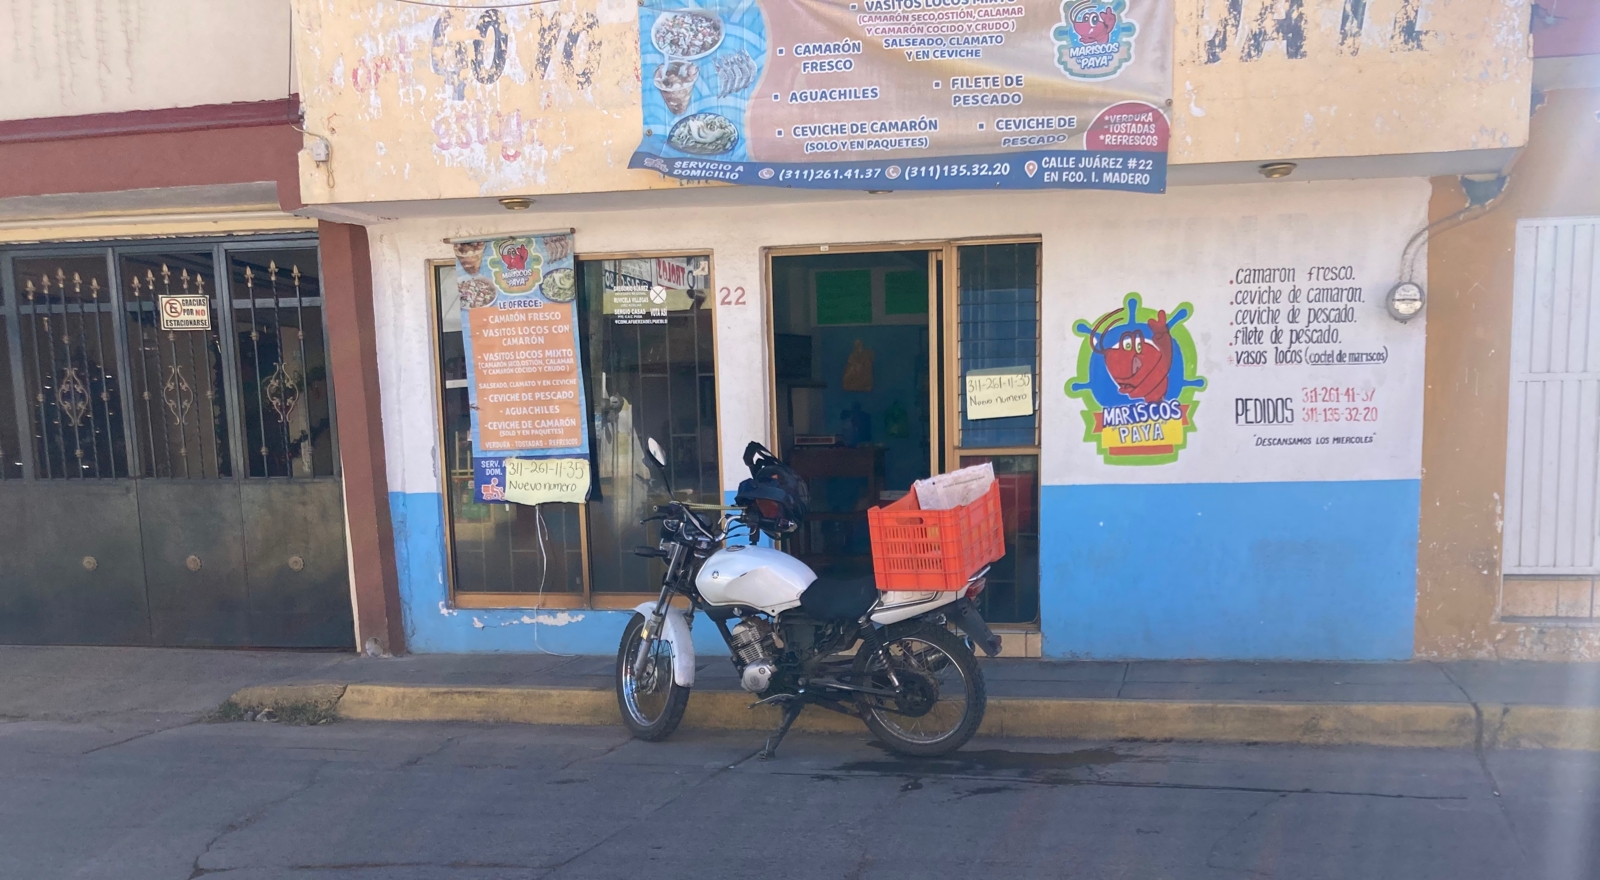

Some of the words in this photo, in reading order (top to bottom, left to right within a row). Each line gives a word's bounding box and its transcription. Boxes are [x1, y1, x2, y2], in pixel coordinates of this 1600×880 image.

[866, 0, 921, 11] VASITOS
[858, 14, 909, 24] (CAMARÓN
[977, 7, 1024, 18] CALAMAR
[874, 24, 924, 34] CAMARÓN
[926, 24, 964, 34] COCIDO
[966, 24, 973, 32] Y
[974, 22, 1009, 31] CRUDO
[794, 40, 862, 56] CAMARÓN
[884, 38, 946, 48] SALSEADO,
[948, 35, 1004, 46] CLAMATO
[906, 52, 912, 60] Y
[916, 50, 930, 60] EN
[932, 49, 982, 58] CEVICHE
[1069, 43, 1120, 58] MARISCOS
[802, 60, 853, 73] FRESCO
[951, 76, 1000, 90] FILETE
[1004, 75, 1024, 87] DE
[789, 88, 879, 102] AGUACHILES
[952, 93, 1022, 106] PESCADO
[792, 124, 850, 138] CEVICHE
[850, 122, 868, 136] DE
[870, 117, 938, 134] CAMARÓN
[995, 118, 1054, 132] CEVICHE
[1056, 116, 1076, 129] DE
[805, 140, 838, 153] (SOLO
[841, 140, 848, 150] Y
[849, 140, 864, 150] EN
[867, 137, 927, 151] PAQUETES)
[1002, 134, 1067, 147] PESCADO
[673, 161, 732, 172] SERVICIO
[1042, 156, 1076, 169] CALLE
[1078, 154, 1123, 170] JUÁREZ
[1127, 158, 1153, 170] #22
[672, 169, 739, 180] DOMICILIO
[779, 167, 882, 182] (311)261.41.37
[904, 163, 1010, 180] (311)135.32.20
[1044, 171, 1060, 183] EN
[1062, 172, 1088, 184] FCO.
[1091, 172, 1099, 183] I.
[1102, 172, 1150, 185] MADERO
[502, 269, 533, 280] MARISCOS
[1235, 267, 1296, 285] camaron
[1307, 266, 1356, 282] fresco.
[719, 286, 746, 306] 22
[1235, 286, 1282, 306] ceviche
[1288, 284, 1302, 304] de
[1306, 286, 1366, 304] camaron.
[182, 298, 206, 307] GRACIAS
[499, 302, 507, 310] LE
[509, 300, 542, 308] OFRECE:
[183, 308, 194, 316] POR
[489, 312, 526, 324] CAMARÓN
[528, 312, 561, 321] FRESCO
[1235, 306, 1281, 326] ceviche
[1287, 304, 1300, 324] de
[1306, 306, 1357, 328] pescado.
[166, 319, 208, 327] ESTACIONARSE
[482, 328, 516, 338] VASITOS
[518, 326, 549, 335] LOCOS
[552, 325, 570, 333] CON
[1234, 326, 1264, 346] filete
[1270, 326, 1284, 344] de
[1289, 325, 1342, 349] pescado.
[502, 336, 544, 346] CAMARÓN
[483, 351, 514, 361] VASITOS
[516, 350, 543, 360] LOCOS
[545, 348, 573, 358] MIXTO
[1235, 349, 1268, 365] vasos
[1274, 347, 1302, 364] locos
[1305, 346, 1334, 364] (coctel
[1336, 350, 1347, 362] de
[488, 367, 514, 375] CAMARÓN
[515, 366, 537, 374] COCIDO
[479, 382, 508, 390] SALSEADO,
[510, 380, 536, 388] CLAMATO
[552, 378, 577, 386] CEVICHE
[968, 373, 1030, 393] 311-261-11-35
[489, 393, 520, 403] CEVICHE
[522, 392, 533, 401] DE
[535, 390, 574, 400] PESCADO
[505, 406, 560, 416] AGUACHILES
[1103, 400, 1182, 428] MARISCOS
[1235, 398, 1294, 424] PEDIDOS
[1302, 406, 1378, 423] 311-135-32-20
[522, 420, 533, 429] DE
[534, 416, 576, 428] CAMARÓN
[500, 430, 516, 438] (SOLO
[531, 428, 564, 437] PAQUETES)
[515, 440, 543, 448] TOSTADAS
[548, 438, 578, 446] REFRESCOS
[1315, 437, 1330, 445] LOS
[481, 460, 500, 468] SERV.
[508, 460, 584, 480] 311-261-11-35
[486, 468, 503, 476] DOM.
[543, 482, 577, 492] numero
